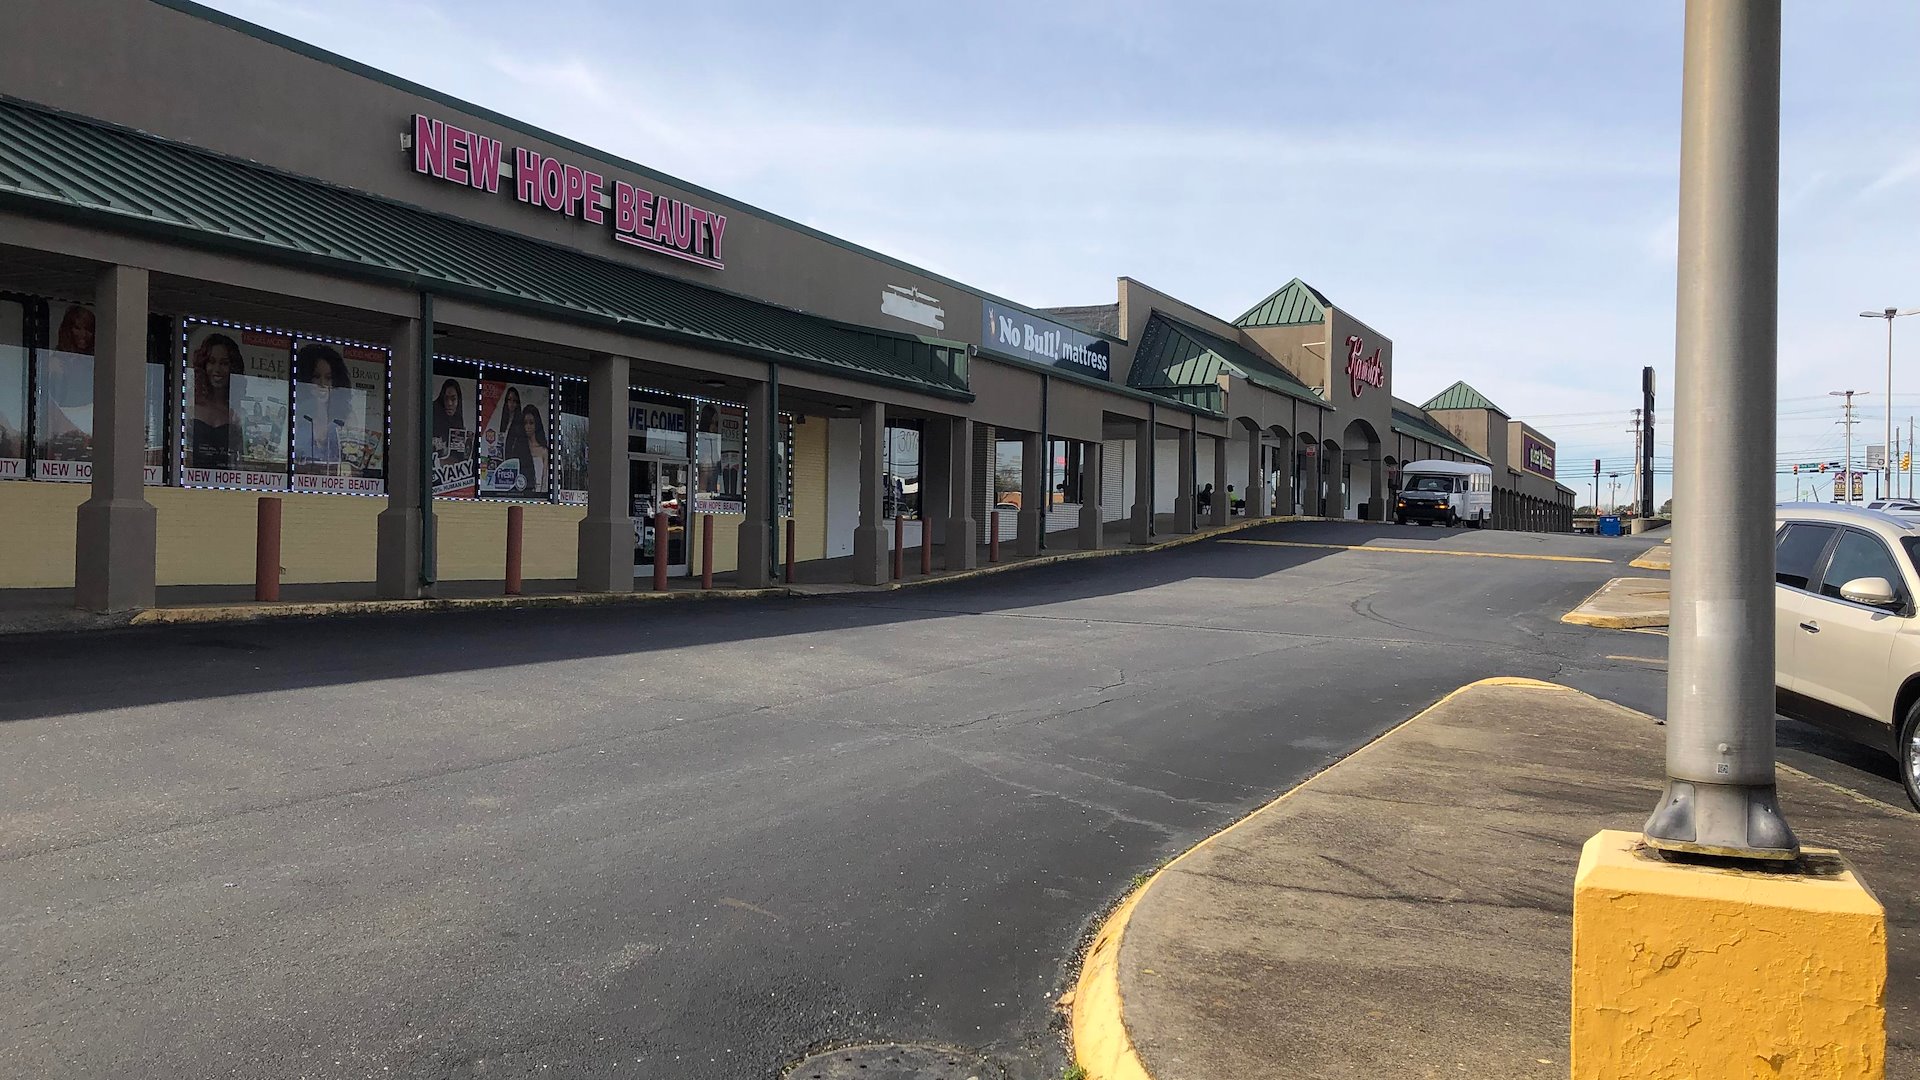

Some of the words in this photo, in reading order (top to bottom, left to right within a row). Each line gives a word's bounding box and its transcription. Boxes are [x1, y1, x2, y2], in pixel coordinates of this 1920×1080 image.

[413, 113, 502, 194] NEW
[514, 147, 603, 224] HOPE
[614, 180, 727, 259] BEAUTY
[999, 315, 1021, 347] No
[1023, 323, 1061, 360] Bull!
[1062, 342, 1108, 372] mattress
[42, 462, 70, 477] NEW
[76, 463, 92, 478] HO
[187, 470, 211, 483] NEW
[215, 471, 242, 485] HOPE
[246, 473, 283, 487] BEAUTY
[438, 460, 473, 483] YAKY
[297, 476, 318, 488] NEW
[321, 477, 344, 490] HOPE
[348, 479, 380, 491] BEAUTY
